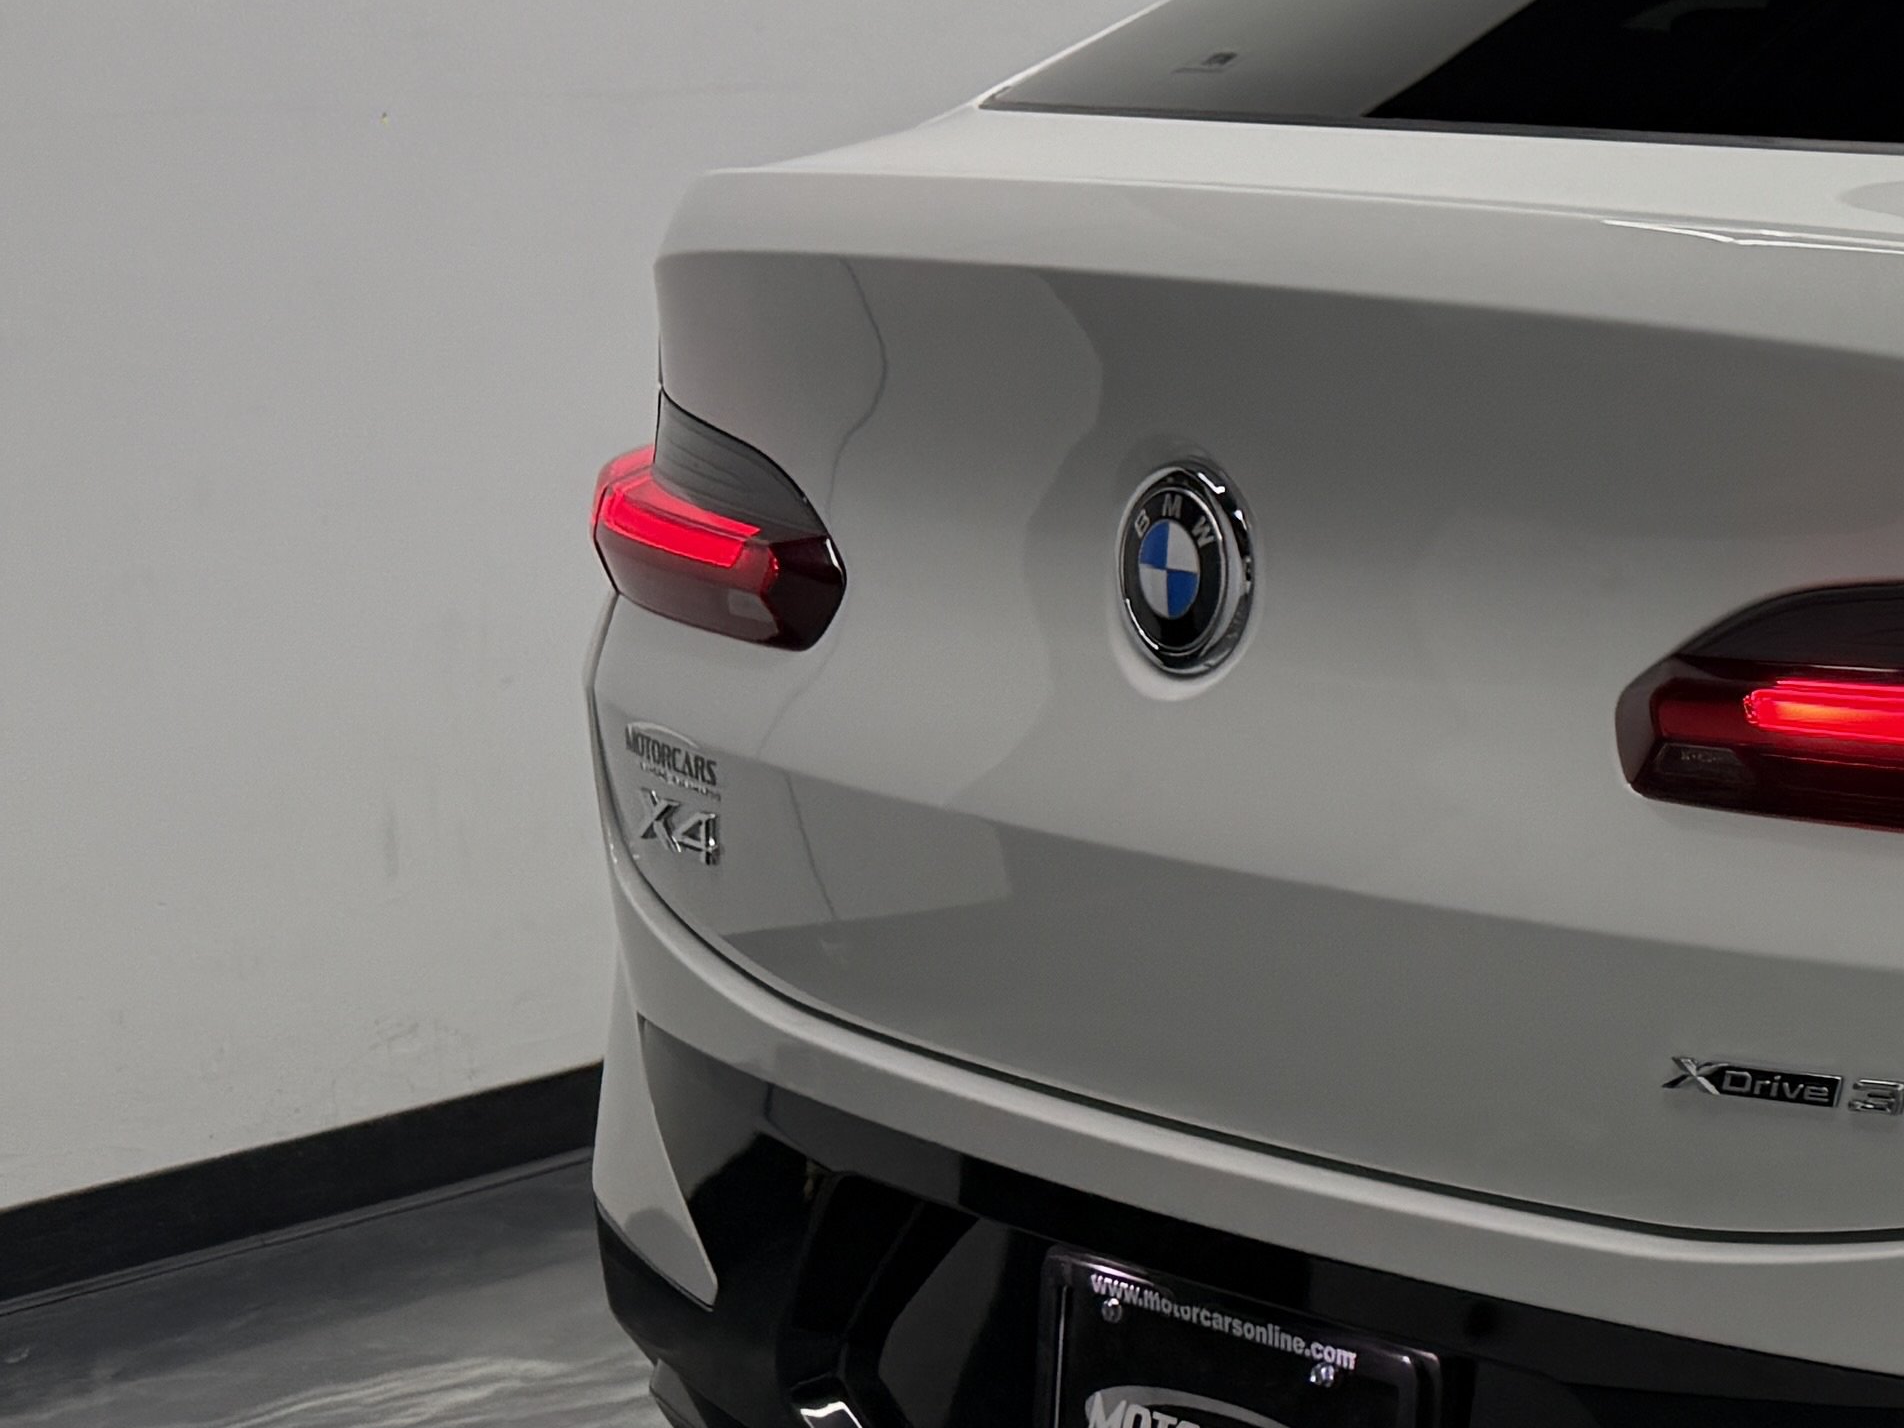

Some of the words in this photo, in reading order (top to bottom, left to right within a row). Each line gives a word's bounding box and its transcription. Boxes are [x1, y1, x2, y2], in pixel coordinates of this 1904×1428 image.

[1133, 492, 1215, 549] BMW
[625, 723, 718, 787] MOTORCARS
[641, 787, 721, 866] X4
[1090, 1273, 1357, 1369] www.motorcarsonline.com
